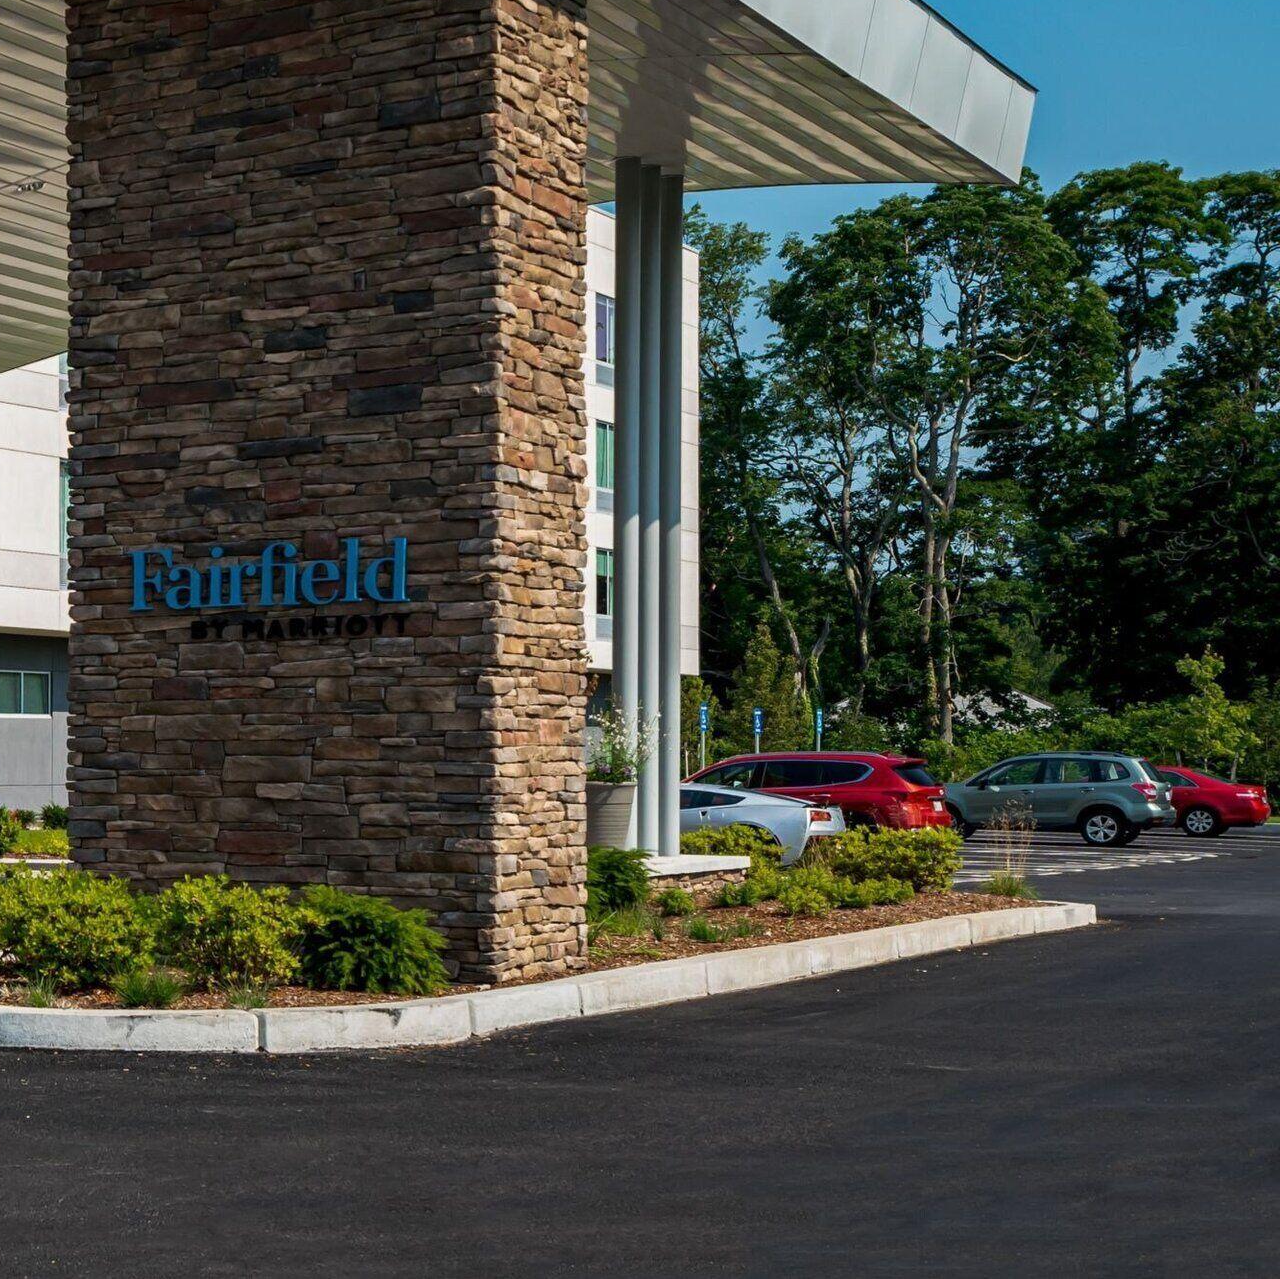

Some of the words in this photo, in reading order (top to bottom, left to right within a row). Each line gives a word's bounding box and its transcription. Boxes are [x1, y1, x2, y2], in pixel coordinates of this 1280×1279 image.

[127, 537, 411, 612] Fairfield
[191, 619, 227, 640] BY
[242, 615, 411, 640] MARRIOTT
